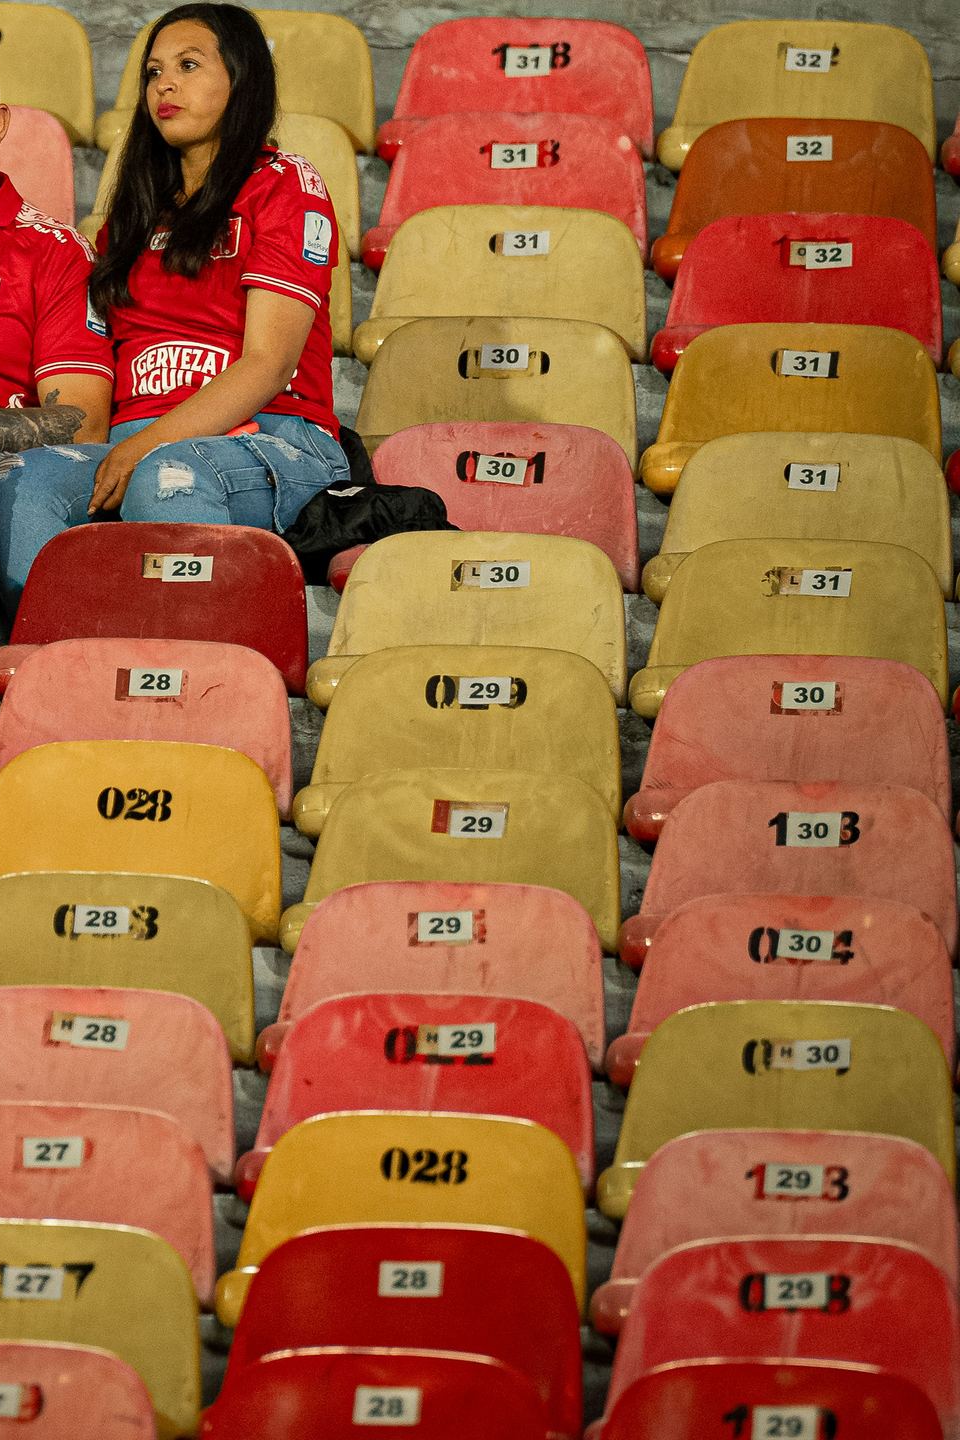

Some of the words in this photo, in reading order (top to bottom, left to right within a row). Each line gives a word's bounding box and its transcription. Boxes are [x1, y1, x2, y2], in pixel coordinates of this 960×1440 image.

[516, 55, 540, 70] 31
[795, 52, 822, 68] 32
[502, 148, 527, 164] 31
[795, 140, 823, 156] 32
[513, 233, 539, 249] 31
[814, 247, 843, 264] 32
[490, 348, 520, 364] 30
[792, 355, 820, 372] 31
[485, 460, 516, 478] 30
[799, 468, 827, 486] 31
[153, 559, 161, 568] L
[171, 560, 202, 577] 29
[472, 567, 480, 576] L
[489, 565, 520, 583] 30
[790, 576, 799, 585] L
[811, 574, 840, 591] 31
[139, 673, 171, 691] 28
[468, 682, 500, 699] 29
[793, 686, 825, 704] 30
[98, 787, 172, 821] 028
[460, 815, 493, 833] 29
[797, 822, 829, 840] 30
[84, 910, 118, 928] 28
[428, 916, 462, 935] 29
[788, 934, 822, 953] 30
[60, 1020, 74, 1031] H
[83, 1023, 117, 1043] 28
[426, 1032, 438, 1043] H
[450, 1029, 484, 1049] 29
[781, 1047, 793, 1058] H
[806, 1044, 841, 1065] 30
[35, 1142, 70, 1162] 27
[381, 1148, 468, 1184] 028
[776, 1169, 812, 1190] 29
[15, 1273, 51, 1294] 27
[391, 1268, 428, 1290] 28
[778, 1278, 815, 1301] 29
[367, 1395, 405, 1419] 28
[766, 1414, 804, 1438] 29
